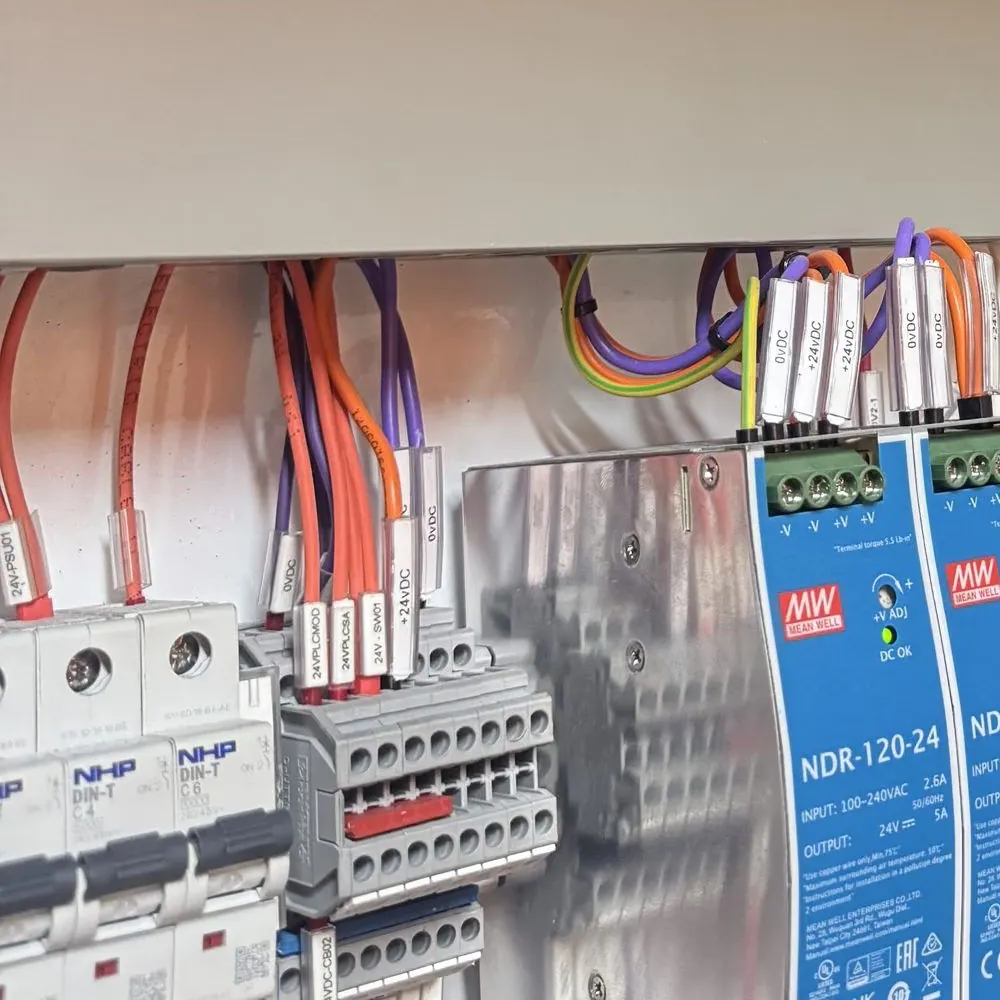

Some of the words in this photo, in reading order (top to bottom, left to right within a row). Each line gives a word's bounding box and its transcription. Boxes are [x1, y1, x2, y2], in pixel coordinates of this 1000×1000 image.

[952, 557, 995, 591] MW
[785, 585, 836, 623] MW
[879, 649, 895, 663] DC
[897, 645, 913, 660] OK
[178, 740, 237, 766] NHP
[801, 725, 940, 784] NDR-120-24
[73, 758, 137, 785] NHP
[180, 762, 221, 783] DIN-T
[73, 783, 116, 805] DIN-T
[801, 801, 837, 823] INPUT:
[923, 772, 947, 790] 2.6A
[804, 834, 852, 859] OUTPUT:
[934, 806, 948, 821] 5A
